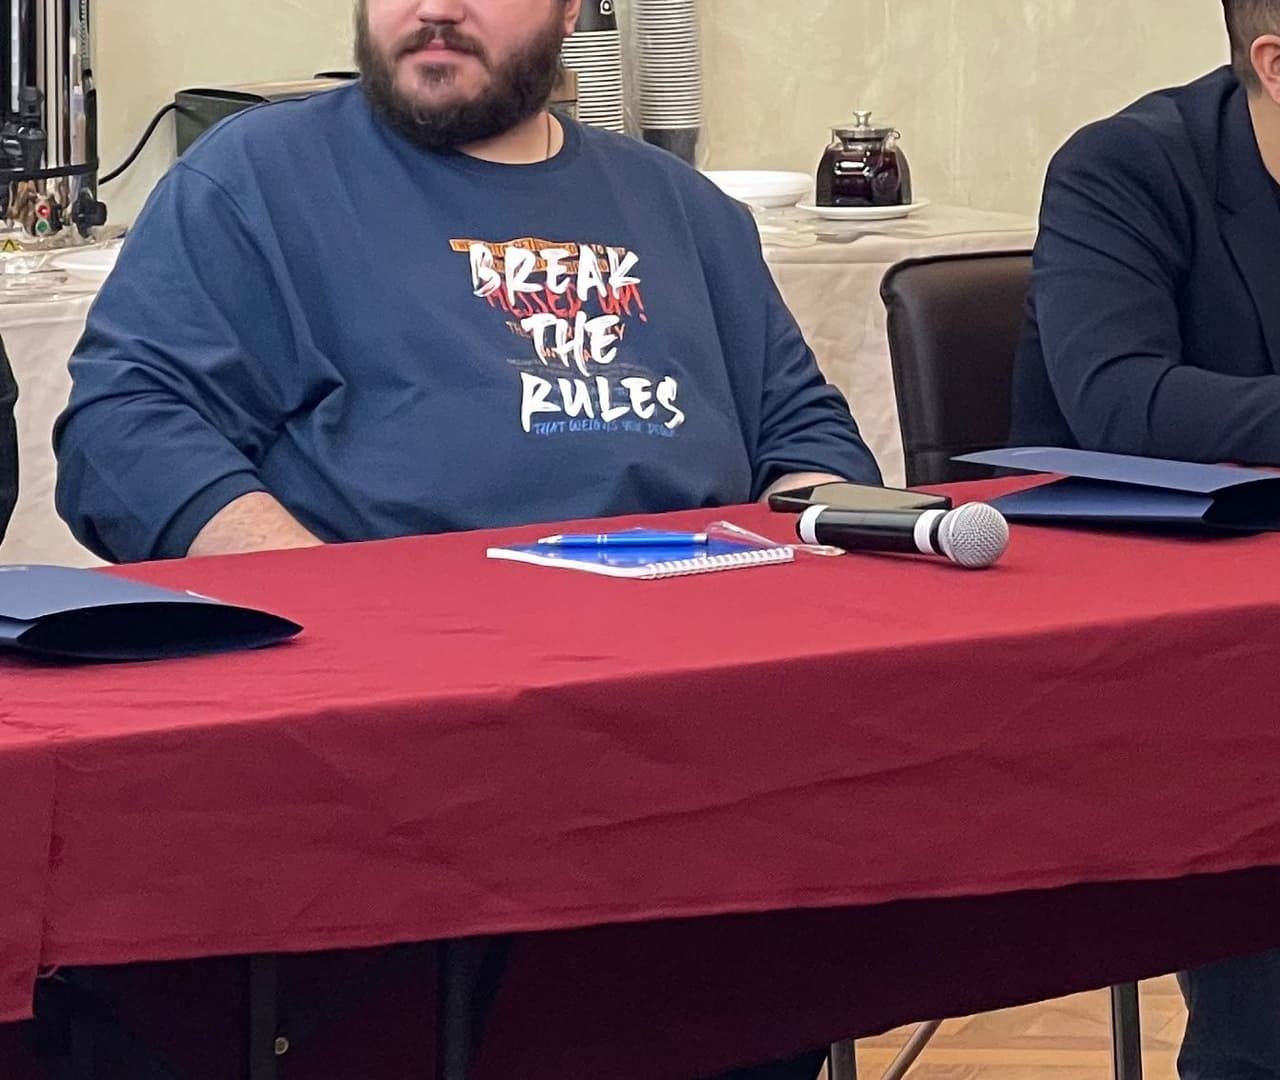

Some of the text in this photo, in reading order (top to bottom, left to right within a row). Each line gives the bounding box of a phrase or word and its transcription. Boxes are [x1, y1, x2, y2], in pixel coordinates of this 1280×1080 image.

[469, 243, 641, 307] BREAK
[521, 310, 620, 377] THE
[520, 372, 685, 433] RULES
